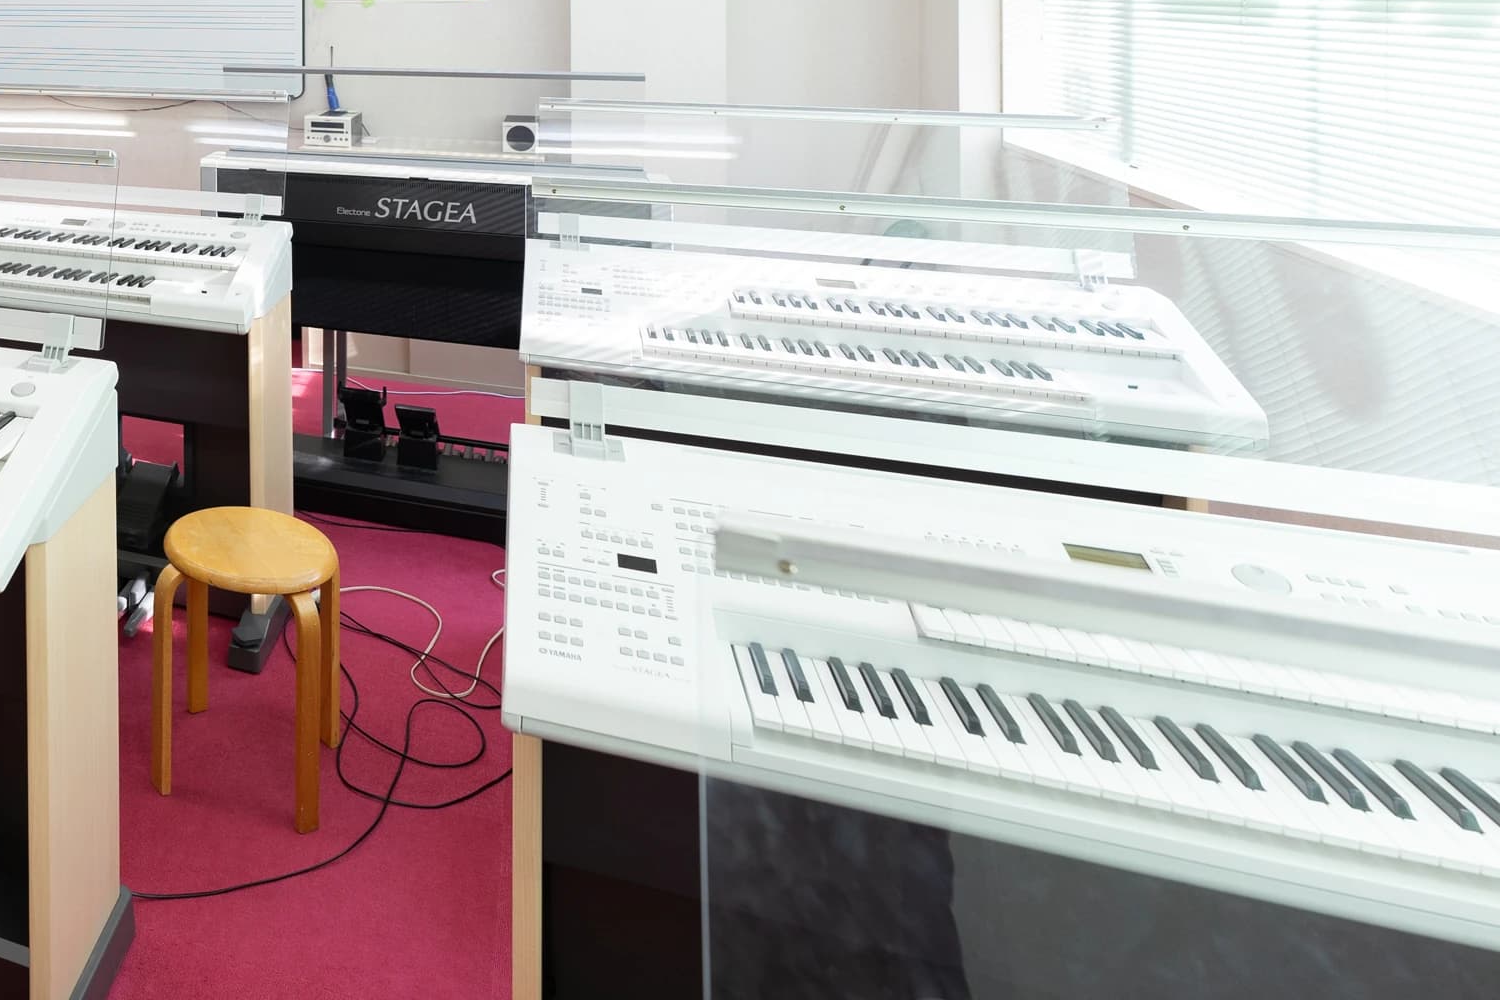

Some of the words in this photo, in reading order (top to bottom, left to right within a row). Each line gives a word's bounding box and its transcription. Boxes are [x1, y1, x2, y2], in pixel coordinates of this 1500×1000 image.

[336, 206, 371, 217] Electone
[374, 197, 477, 224] STAGEA
[548, 648, 582, 662] YAMAHA
